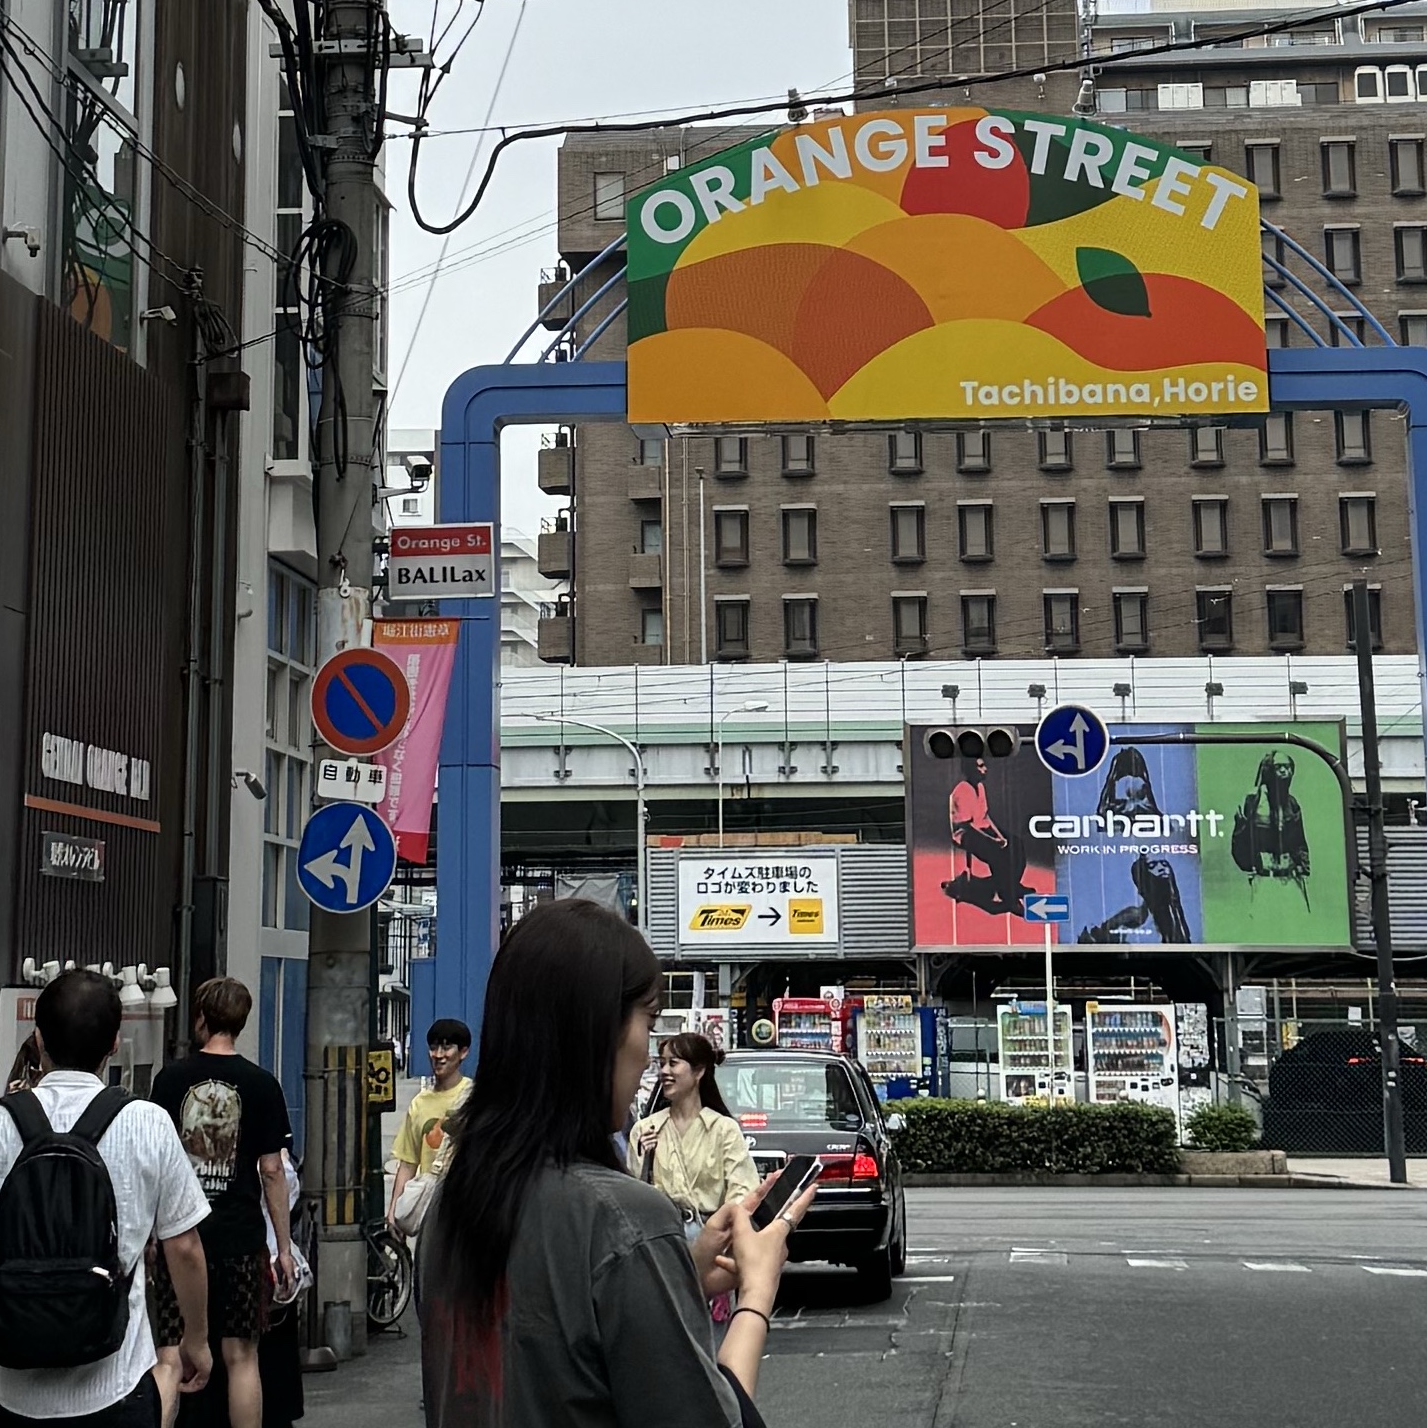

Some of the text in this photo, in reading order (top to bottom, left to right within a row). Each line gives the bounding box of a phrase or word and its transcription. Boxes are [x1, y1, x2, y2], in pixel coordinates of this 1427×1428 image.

[640, 114, 1248, 245] ORANGE STREET
[397, 534, 488, 551] Orange St.
[323, 763, 383, 786] 自動車
[1057, 844, 1199, 855] WORK IN PROGRESS
[703, 866, 812, 880] タイムズ駐車場の
[696, 881, 819, 894] ロゴが変わりました
[699, 908, 745, 927] Times
